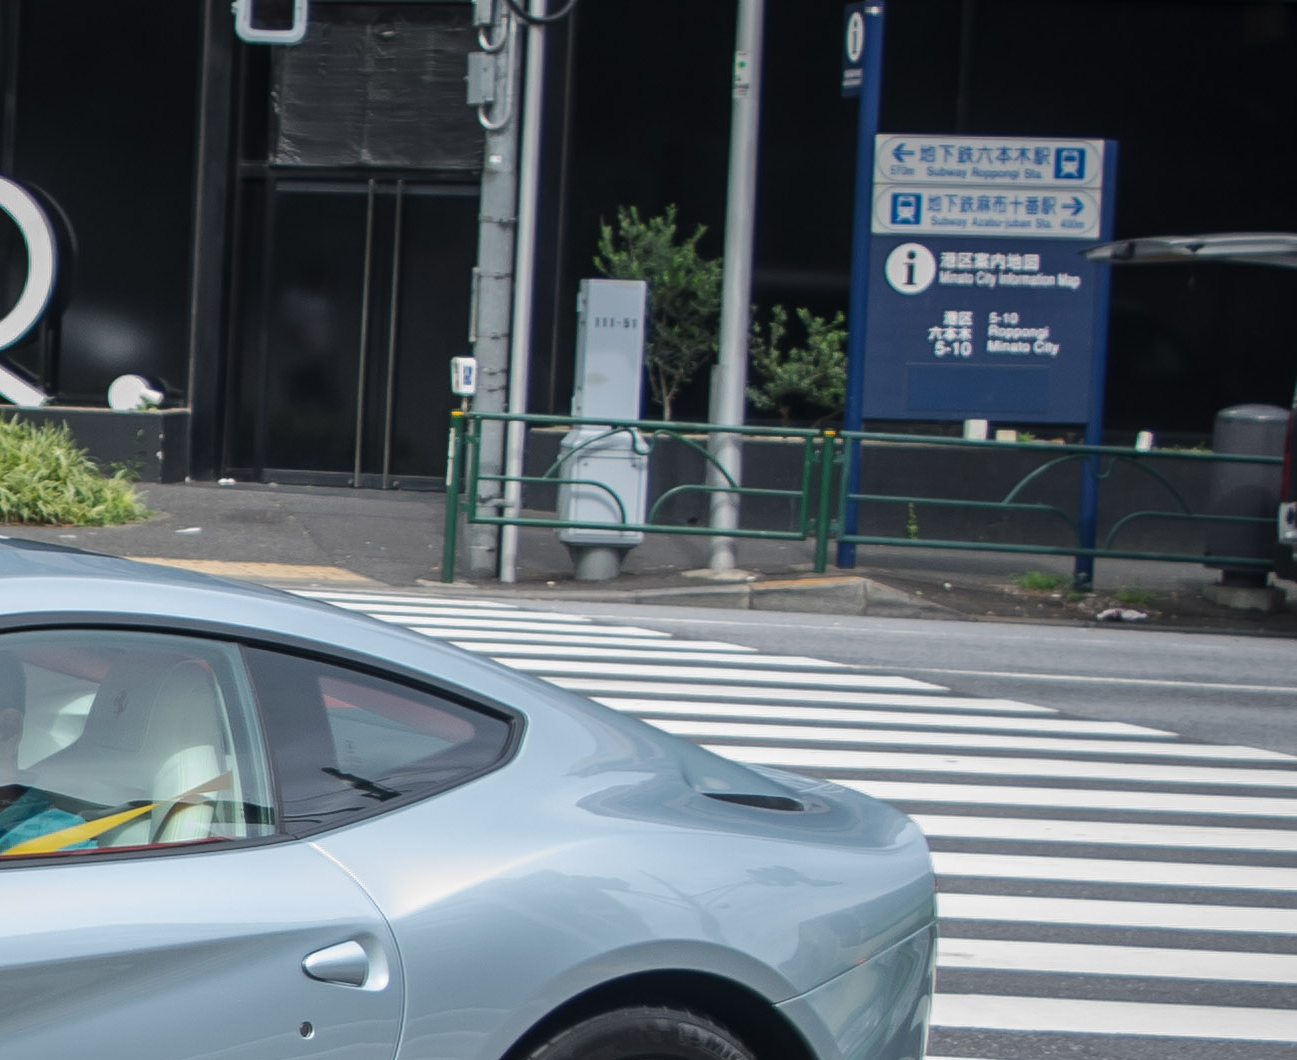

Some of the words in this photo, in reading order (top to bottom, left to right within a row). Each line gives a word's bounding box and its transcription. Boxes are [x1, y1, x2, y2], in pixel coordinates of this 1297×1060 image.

[919, 144, 1051, 165] 地下鉄六本木駅
[927, 166, 967, 178] Subway
[972, 167, 1020, 180] Roppongi
[927, 194, 1056, 215] 地下鉄麻布十番駅
[931, 215, 967, 227] Subway
[939, 252, 1040, 271] 港区案内地図
[938, 270, 974, 285] Minato
[975, 271, 997, 288] City
[998, 272, 1056, 287] Information
[1057, 273, 1082, 290] Map
[943, 310, 973, 326] 港区
[988, 311, 1020, 325] 5-10
[927, 326, 972, 342] 六本木
[988, 325, 1050, 340] Roppongi
[934, 340, 972, 358] 5-10
[987, 340, 1031, 353] Minato
[1033, 341, 1060, 356] City
